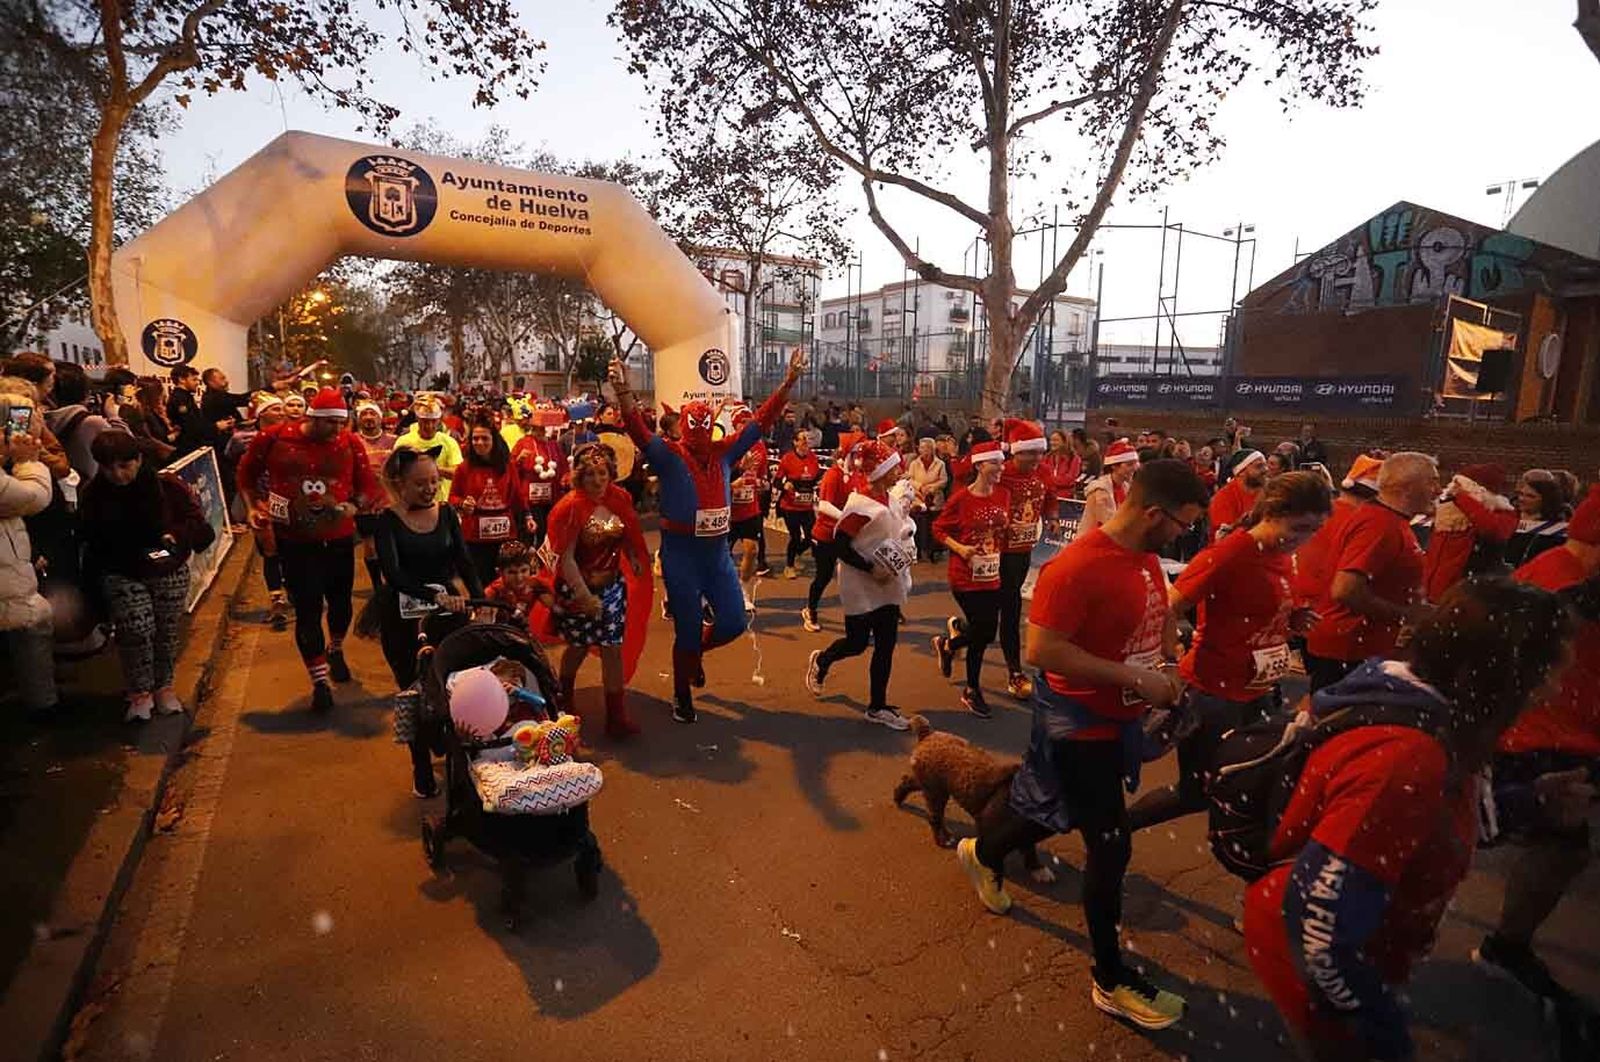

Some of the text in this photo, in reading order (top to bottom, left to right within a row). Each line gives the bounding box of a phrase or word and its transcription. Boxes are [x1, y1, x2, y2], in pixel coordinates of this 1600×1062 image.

[441, 171, 588, 204] Ayuntamiento
[486, 193, 590, 221] de Huelva
[449, 209, 592, 236] Concejalía de Deportes
[1112, 384, 1148, 392] HYUNDAI
[1173, 384, 1214, 393] HYUNDAI
[1254, 384, 1302, 393] HYUNDAI
[1337, 385, 1395, 394] HYUNDAI
[889, 551, 905, 570] 349
